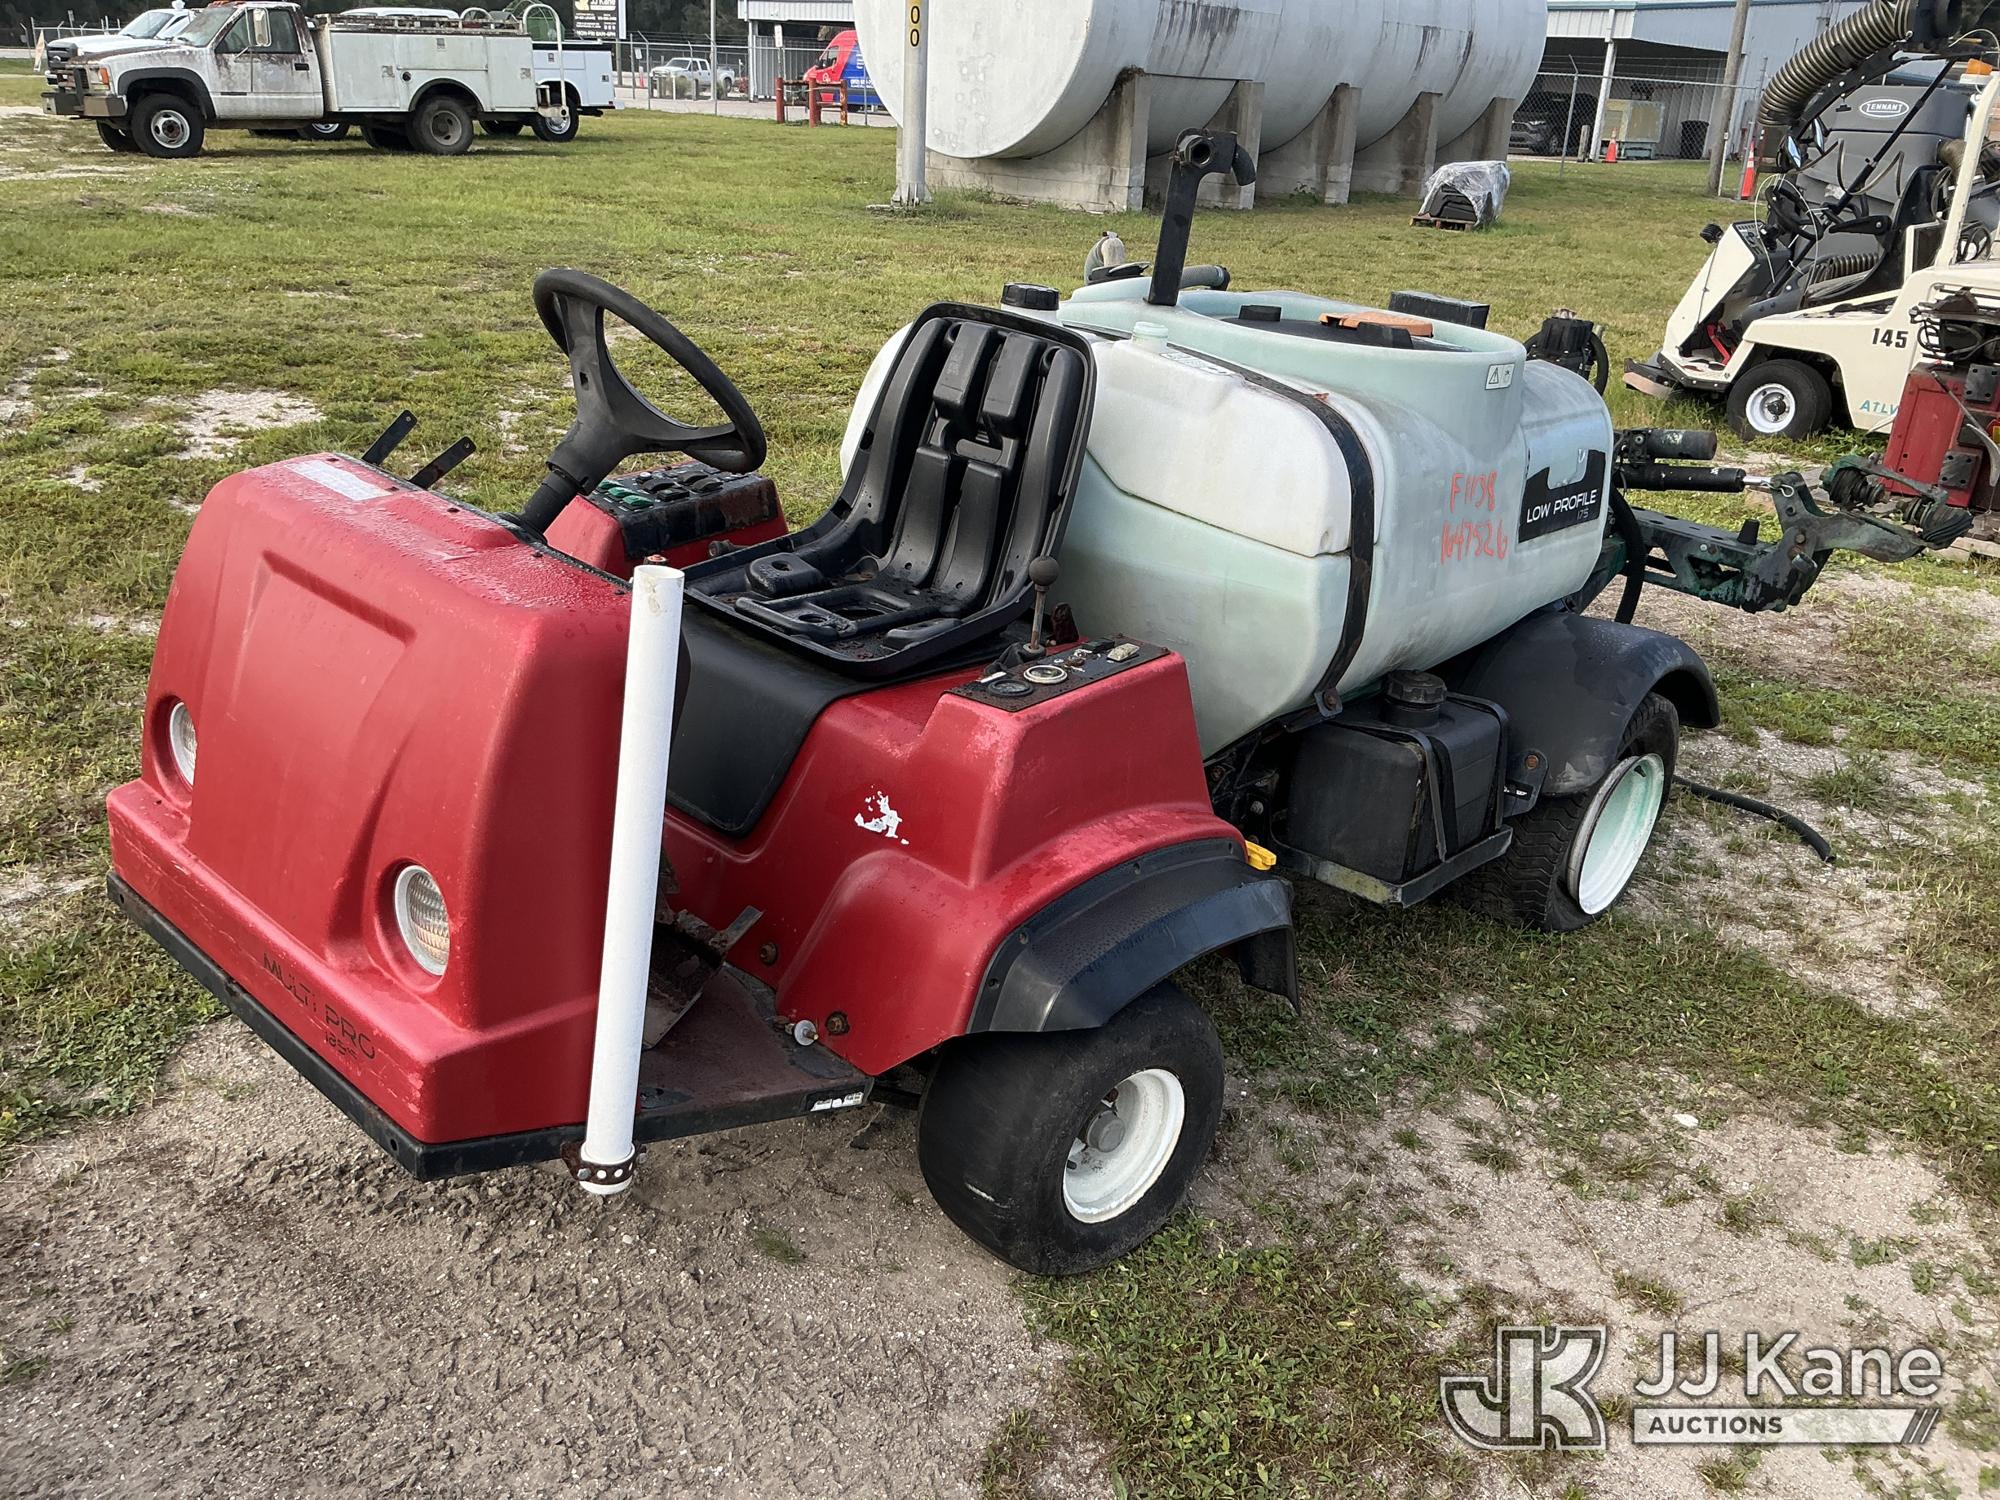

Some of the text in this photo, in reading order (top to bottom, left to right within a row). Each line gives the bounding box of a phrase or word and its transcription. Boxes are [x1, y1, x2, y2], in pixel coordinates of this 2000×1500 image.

[1866, 103, 1904, 113] TENNANT
[1872, 327, 1909, 349] 145
[1526, 489, 1598, 523] LOW PROFILE
